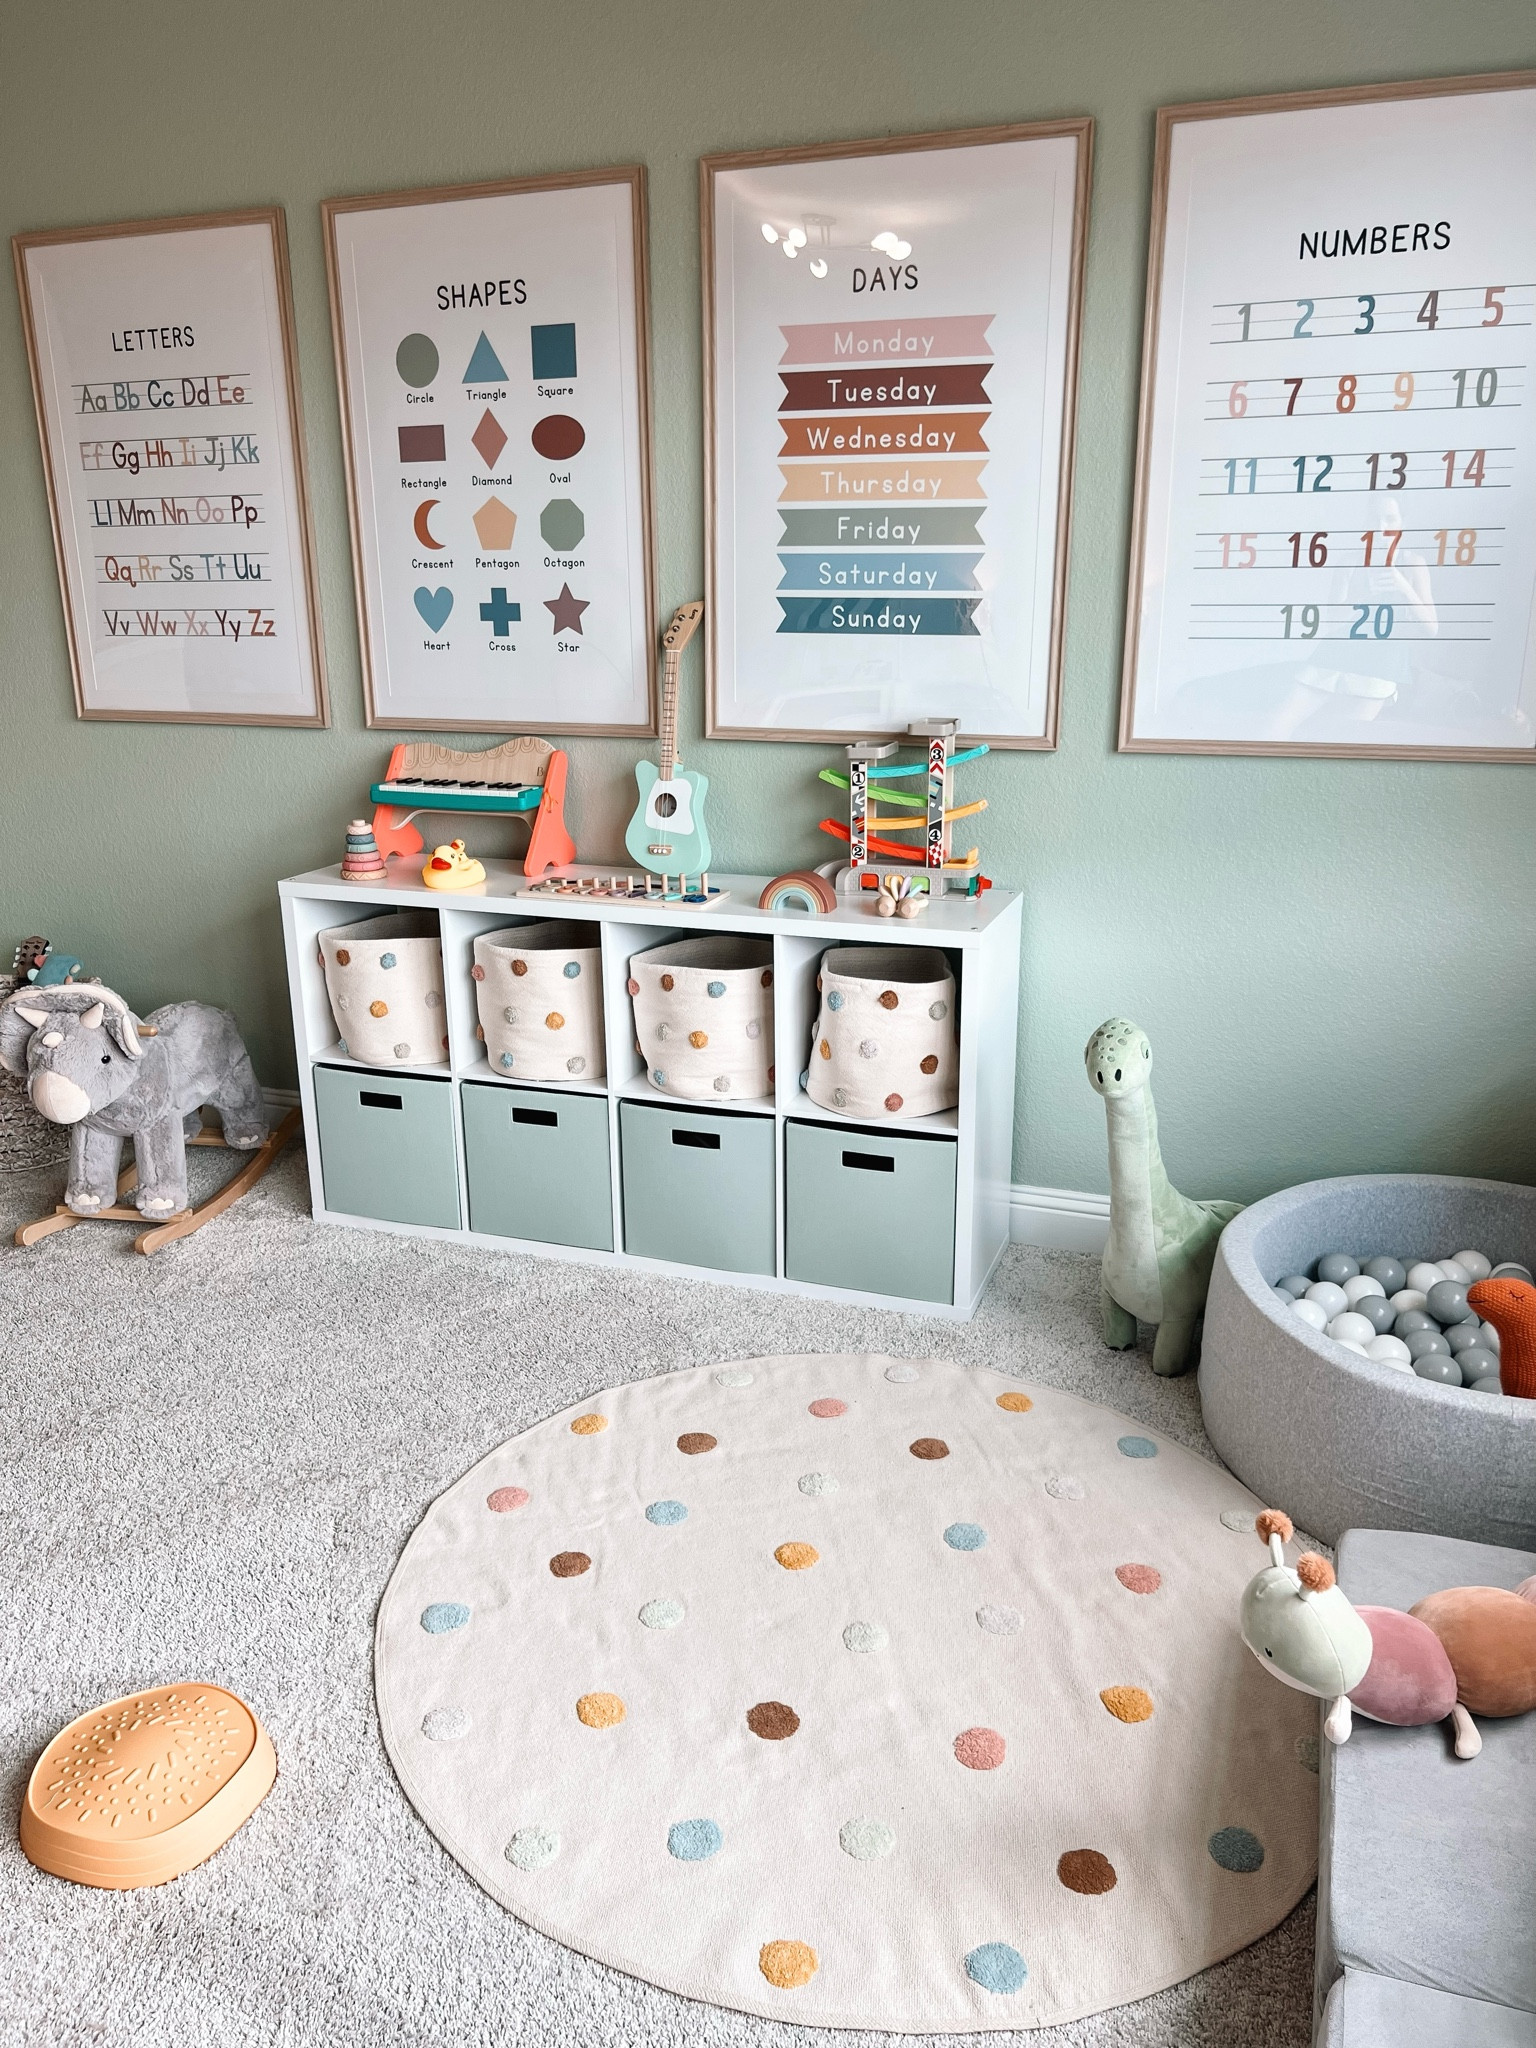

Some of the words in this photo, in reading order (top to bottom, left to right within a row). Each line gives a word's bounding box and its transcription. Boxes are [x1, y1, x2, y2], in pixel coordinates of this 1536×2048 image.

[1299, 221, 1451, 260] NUMBERS
[853, 264, 918, 293] DAYS
[437, 279, 527, 310] SHAPES
[1238, 303, 1251, 342] 1
[1294, 299, 1314, 338] 2
[1354, 295, 1376, 335] 3
[1417, 291, 1439, 330] 4
[1481, 287, 1506, 327] 5
[112, 326, 195, 352] LETTERS
[834, 328, 934, 357] Monday
[82, 385, 107, 412] Aa
[113, 382, 140, 410] Bb
[147, 380, 174, 408] Cc
[181, 377, 209, 406] Dd
[217, 376, 245, 404] Ee
[406, 392, 434, 404] Circle
[466, 388, 507, 401] Triangle
[537, 385, 574, 398] Square
[827, 376, 936, 405] Tuesday
[1228, 381, 1248, 418] 6
[1284, 378, 1303, 416] 7
[1335, 374, 1357, 413] 8
[1393, 371, 1414, 411] 9
[1452, 368, 1498, 408] 10
[806, 423, 956, 452] Wednesday
[80, 443, 103, 470] Ff
[112, 442, 140, 475] Gg
[145, 440, 173, 467] Hh
[179, 437, 196, 466] Ii
[204, 437, 225, 472] Jj
[232, 436, 260, 463] Kk
[401, 477, 447, 490] Rectangle
[472, 475, 513, 486] Diamond
[550, 472, 571, 484] Oval
[821, 470, 942, 498] Thursday
[1224, 458, 1257, 495] 11
[1293, 455, 1333, 493] 12
[1366, 452, 1408, 490] 13
[1442, 450, 1486, 488] 14
[118, 499, 155, 526] Mm
[161, 497, 189, 525] Nn
[196, 497, 224, 522] Oo
[231, 495, 258, 529] Pp
[837, 516, 921, 544] Friday
[1219, 533, 1257, 568] 15
[1288, 531, 1328, 568] 16
[1361, 530, 1403, 567] 17
[1433, 529, 1477, 566] 18
[105, 556, 137, 588] Qq
[138, 555, 162, 580] Rr
[169, 555, 194, 581] Ss
[200, 554, 226, 580] Tt
[234, 554, 261, 580] Uu
[412, 558, 454, 569] Crescent
[475, 558, 520, 570] Pentagon
[544, 557, 585, 570] Octagon
[819, 562, 937, 590] Saturday
[104, 611, 130, 635] Vv
[136, 611, 177, 635] Ww
[184, 611, 209, 635] Xx
[215, 610, 241, 642] Yy
[248, 609, 276, 636] Zz
[832, 605, 921, 633] Sunday
[1280, 604, 1320, 639] 19
[1350, 604, 1394, 639] 20
[424, 641, 450, 651] Heart
[489, 641, 516, 652] Cross
[558, 642, 580, 652] Star
[930, 830, 941, 841] 4
